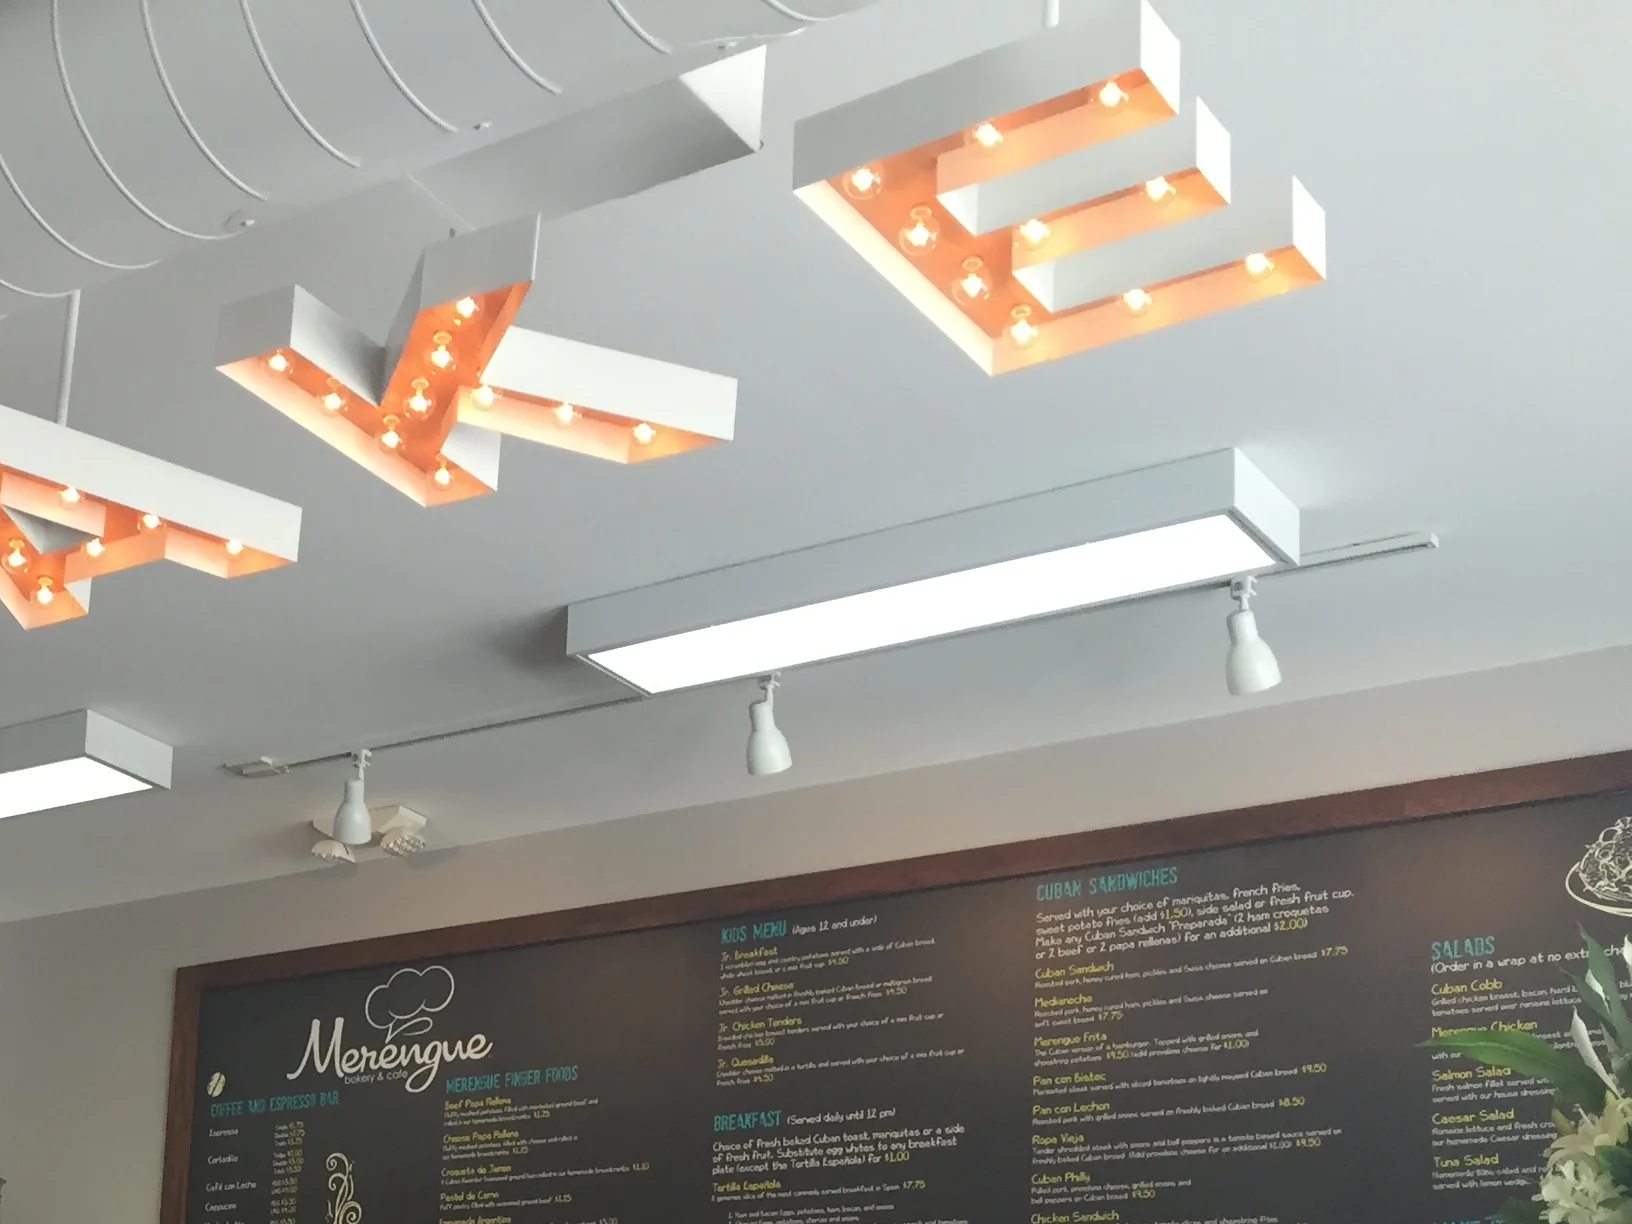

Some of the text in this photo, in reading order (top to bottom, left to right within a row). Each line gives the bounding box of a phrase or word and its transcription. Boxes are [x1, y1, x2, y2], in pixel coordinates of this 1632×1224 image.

[1037, 867, 1178, 901] CUBAN SANDWICHES
[1036, 910, 1072, 922] Served
[1074, 907, 1094, 918] with
[1096, 907, 1118, 916] your
[1120, 902, 1154, 912] choice
[1156, 896, 1170, 908] of
[1233, 886, 1268, 898] french
[1272, 883, 1302, 895] fries,
[1036, 924, 1065, 935] sweet
[1068, 920, 1103, 932] potato
[1106, 916, 1131, 926] fries
[1196, 904, 1219, 916] side
[1222, 900, 1252, 914] salad
[1254, 900, 1266, 908] or
[1269, 895, 1301, 906] fresh
[1304, 891, 1328, 902] fruit
[1332, 890, 1354, 898] cup.
[722, 916, 877, 942] KIDS MENU (Ages 12 and under)
[1035, 934, 1062, 946] Make
[1065, 931, 1082, 944] any
[1084, 930, 1116, 941] Cuban
[1118, 924, 1166, 937] Sandwich
[1247, 912, 1270, 924] ham
[1272, 905, 1330, 919] croquetas
[1048, 948, 1055, 958] 2
[1057, 942, 1083, 957] beef
[1100, 941, 1106, 952] 2
[1109, 942, 1135, 952] papa
[1184, 932, 1200, 942] for
[1203, 932, 1217, 940] an
[1219, 923, 1271, 937] additional
[1432, 936, 1495, 960] SALADS
[1035, 961, 1114, 979] Cuban Sandwich
[1430, 961, 1470, 973] (Order
[1486, 960, 1494, 968] a
[1497, 958, 1526, 966] wrap
[1529, 953, 1544, 964] at
[1547, 954, 1562, 962] no
[1564, 948, 1591, 960] ext
[286, 1017, 494, 1094] Merengue
[344, 1072, 375, 1085] bakery
[377, 1071, 385, 1081] &
[446, 1066, 578, 1092] MERENGUE FINGER FOODS
[211, 1091, 338, 1117] COFFEE AND ESPRESSO BAR
[1432, 1109, 1514, 1124] Caesar Salad
[714, 1108, 896, 1130] BREAKFAST (Served daily until 12 pm)
[712, 1142, 741, 1152] Choice
[742, 1139, 754, 1149] of
[756, 1138, 781, 1148] fresh
[782, 1136, 812, 1146] baked
[812, 1134, 841, 1144] Cuban
[922, 1128, 933, 1138] or
[935, 1128, 942, 1138] a
[944, 1124, 965, 1134] side
[712, 1153, 724, 1163] of
[726, 1152, 750, 1162] fresh
[777, 1148, 824, 1160] Substitute
[826, 1147, 844, 1156] egg
[845, 1143, 875, 1155] whites
[877, 1141, 888, 1151] to
[890, 1143, 906, 1153] any
[908, 1137, 957, 1148] breakfast
[712, 1165, 734, 1175] plate
[736, 1162, 769, 1172] (except
[772, 1161, 788, 1170] the
[791, 1158, 820, 1168] Tortilla
[868, 1153, 882, 1163] for
[1030, 1210, 1120, 1224] Chicken Sandwich
